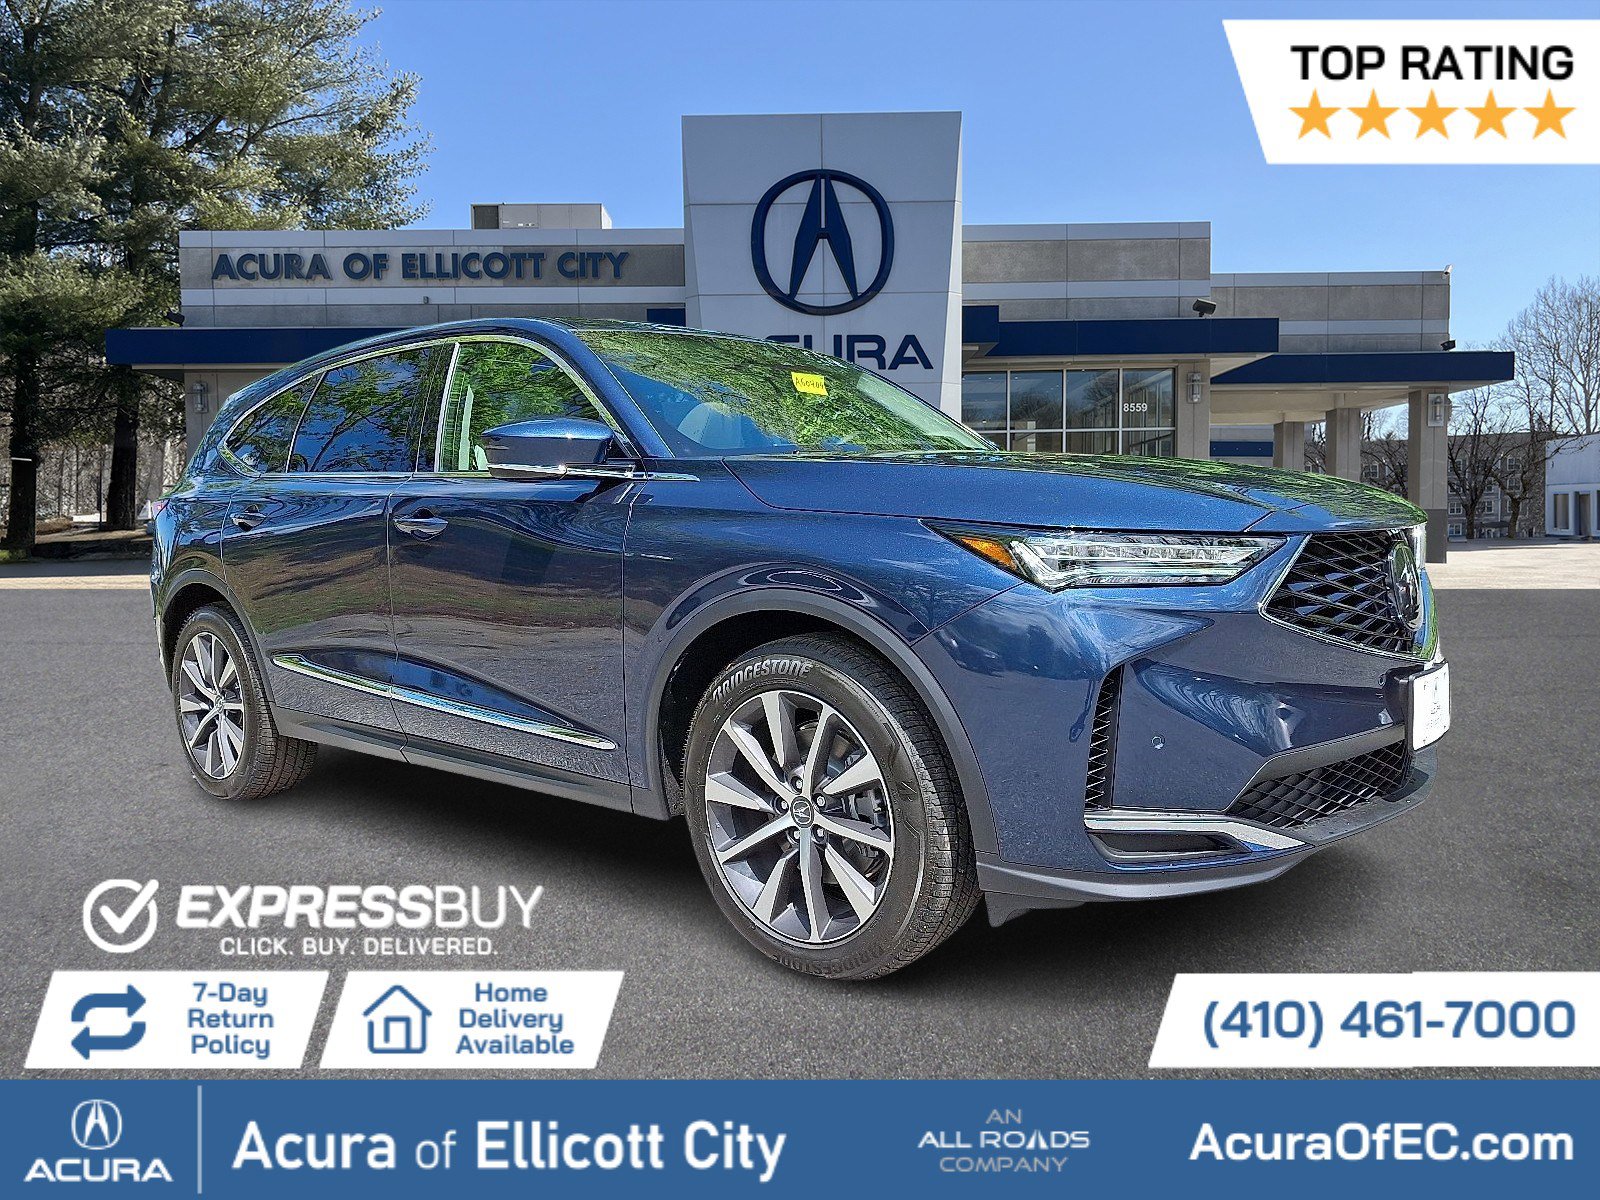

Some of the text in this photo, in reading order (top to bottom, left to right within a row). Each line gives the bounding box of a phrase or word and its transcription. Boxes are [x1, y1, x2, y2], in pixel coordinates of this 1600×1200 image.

[211, 251, 630, 281] ACURA OF ELLICOTT CITY
[1123, 402, 1148, 412] 8559
[711, 659, 814, 703] BRIDGESTONE
